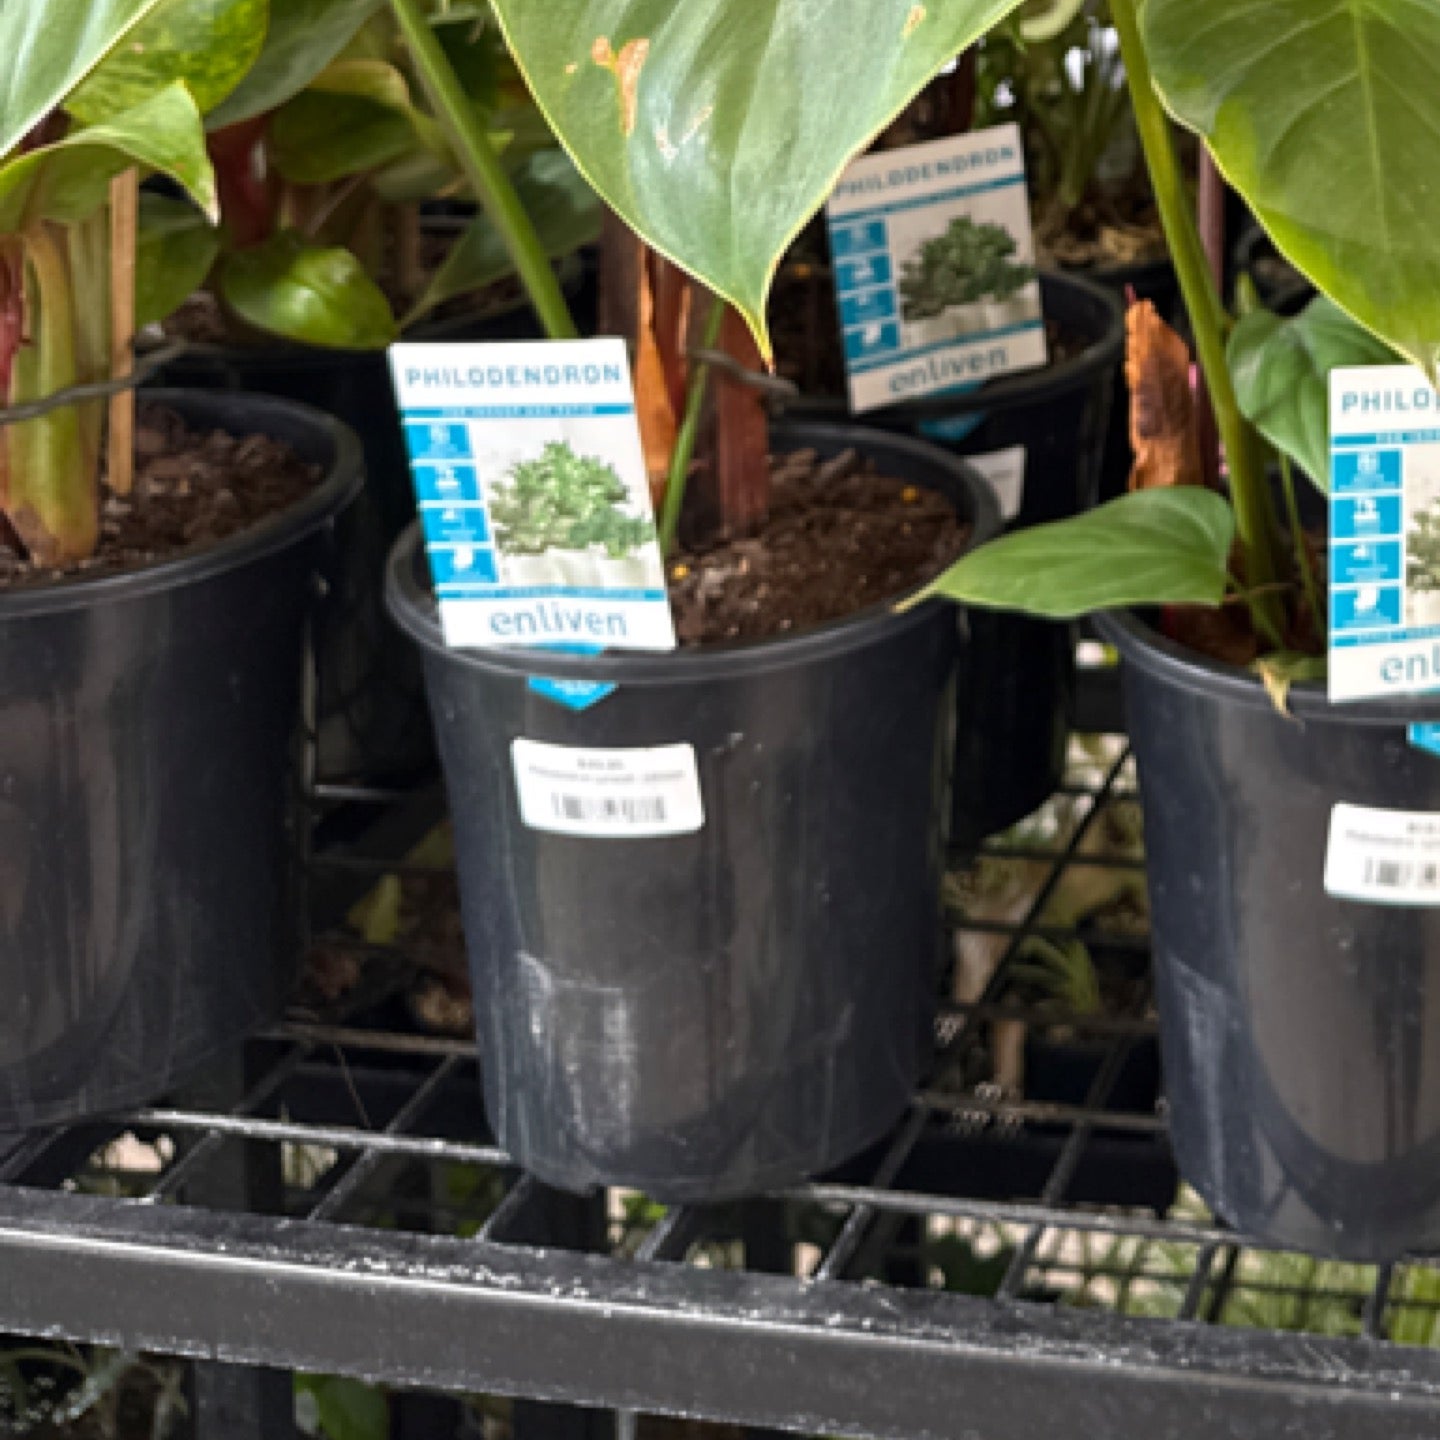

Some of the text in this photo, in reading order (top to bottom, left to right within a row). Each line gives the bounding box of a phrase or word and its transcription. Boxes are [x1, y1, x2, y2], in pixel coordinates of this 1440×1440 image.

[404, 365, 621, 386] PHILODENDRON
[889, 348, 1007, 392] enliven
[489, 605, 627, 636] enliven
